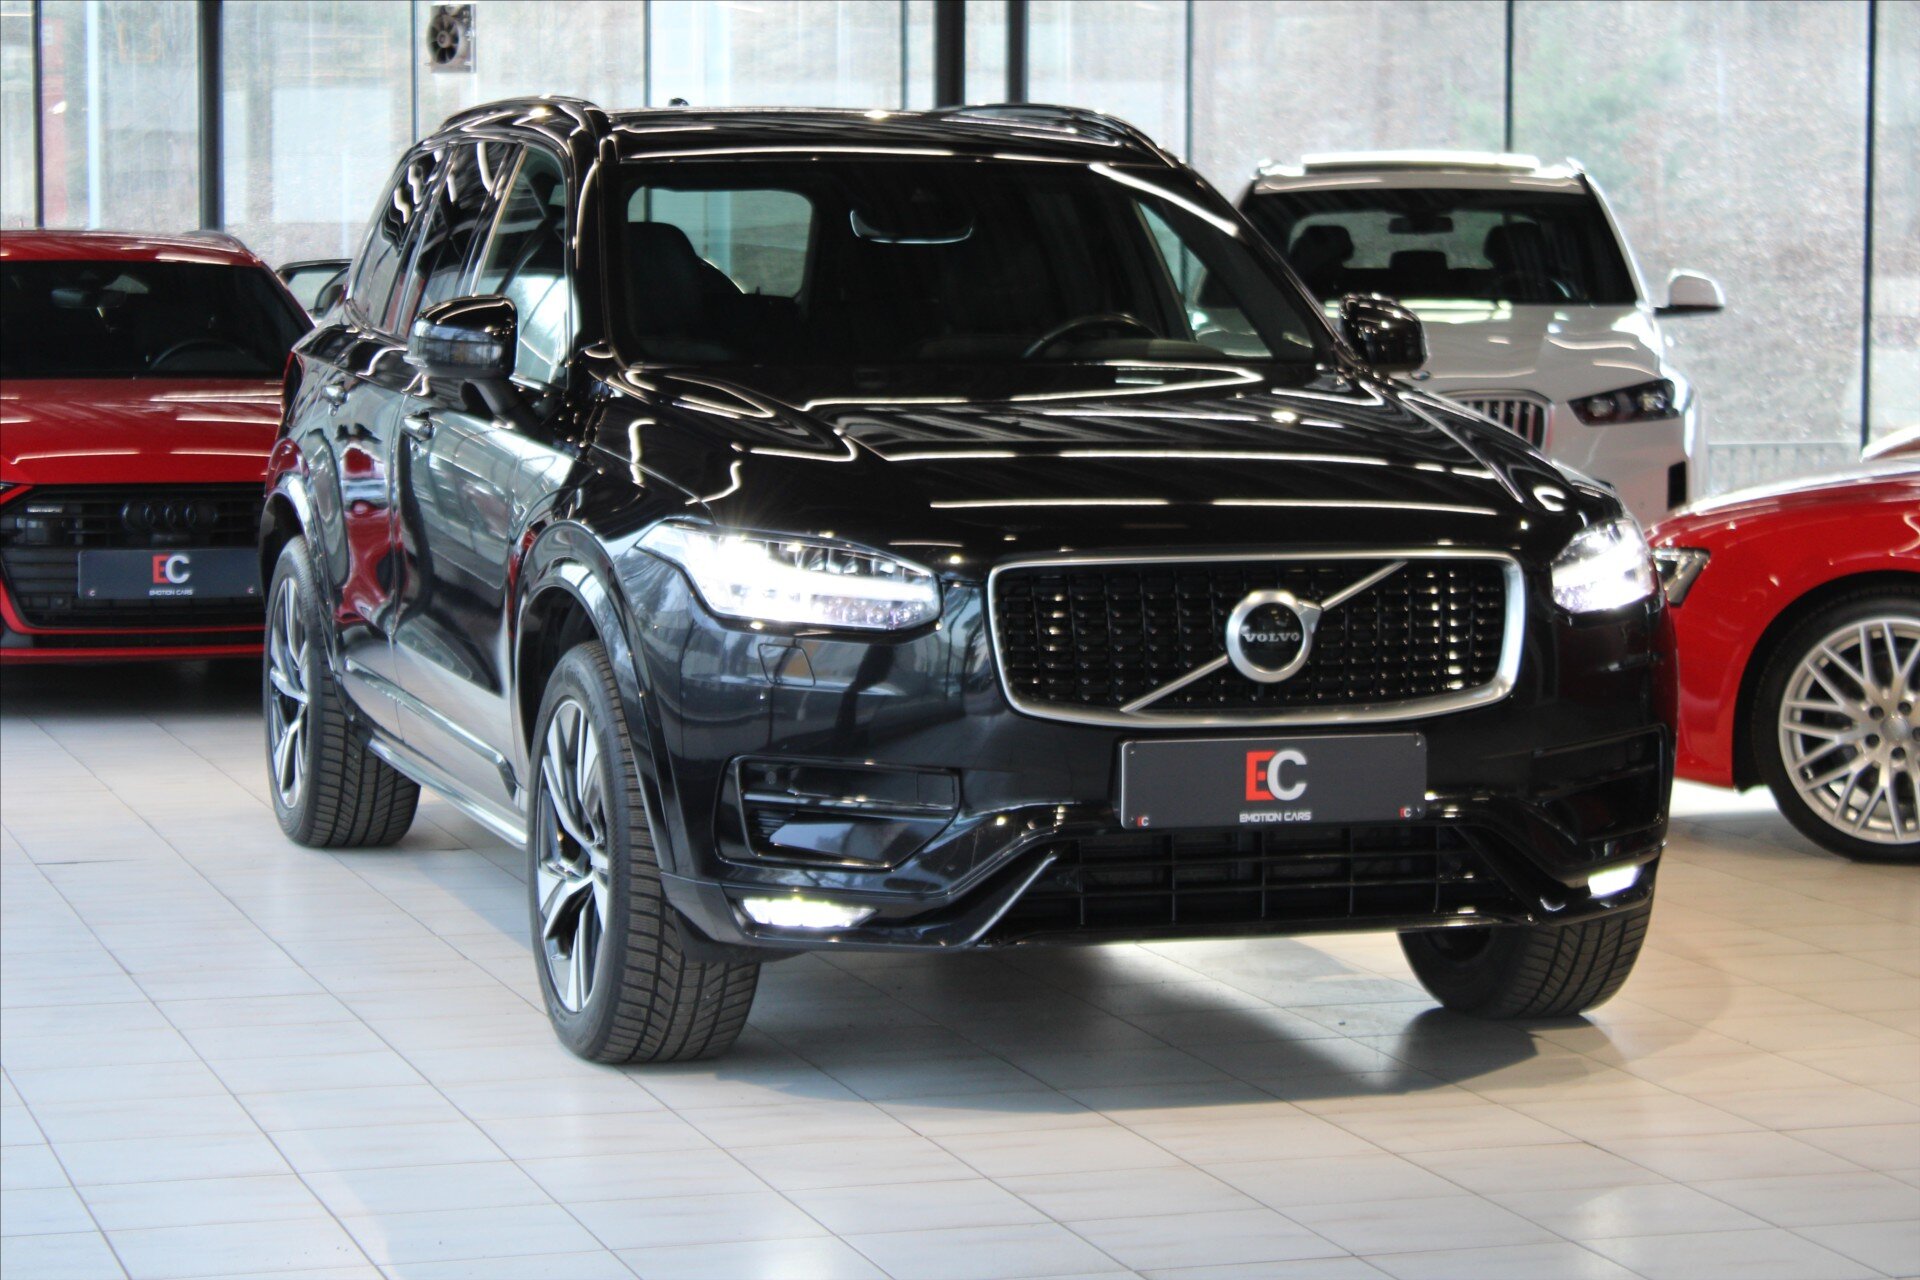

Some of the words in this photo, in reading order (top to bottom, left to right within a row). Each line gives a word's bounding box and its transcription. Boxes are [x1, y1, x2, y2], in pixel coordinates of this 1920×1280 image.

[152, 554, 190, 584] EC
[1244, 632, 1300, 642] VOLVO
[1245, 750, 1307, 801] EC
[1239, 812, 1282, 823] EMOTION
[1283, 811, 1312, 821] CARS
